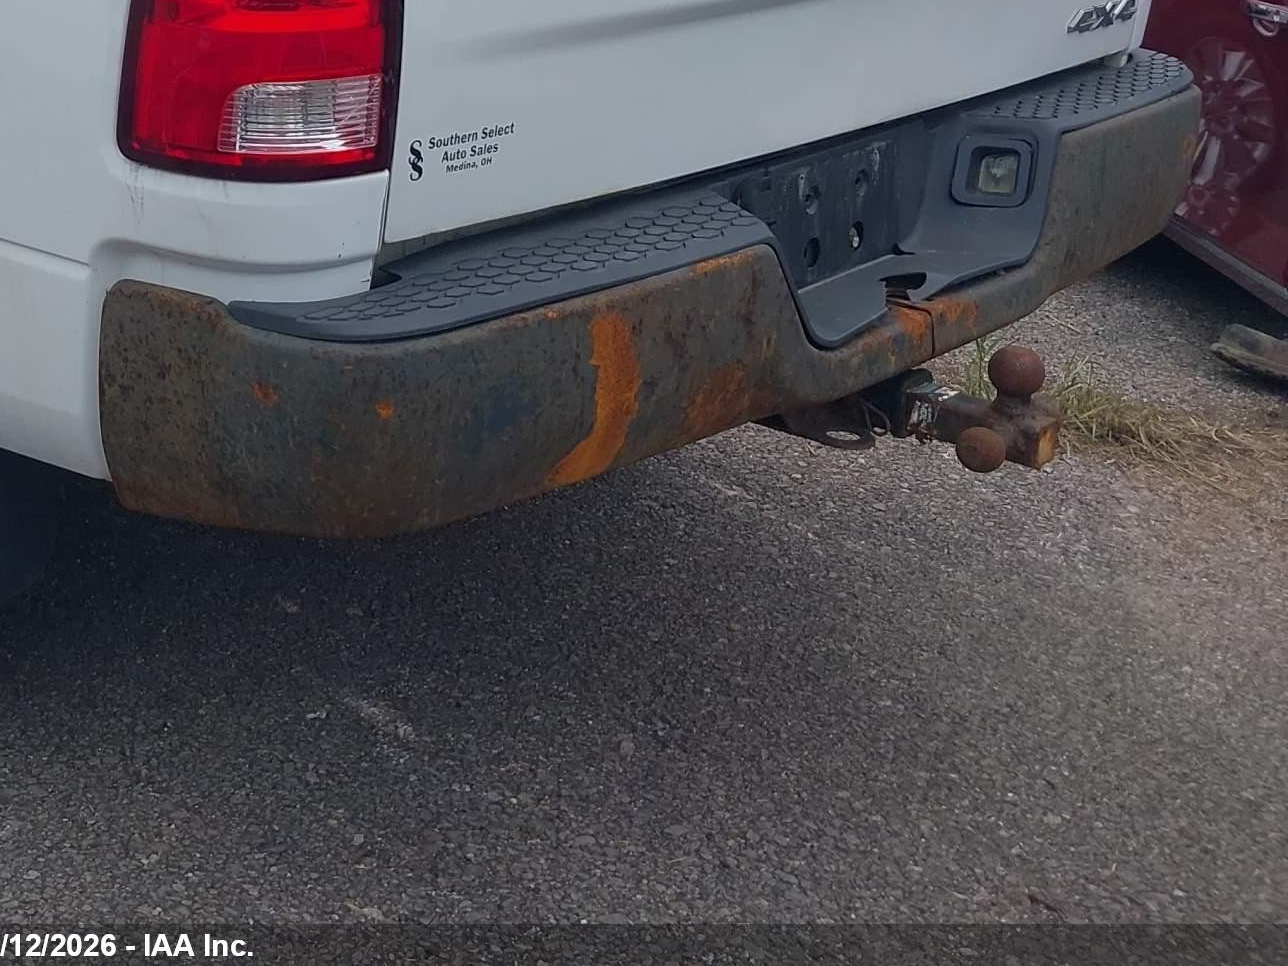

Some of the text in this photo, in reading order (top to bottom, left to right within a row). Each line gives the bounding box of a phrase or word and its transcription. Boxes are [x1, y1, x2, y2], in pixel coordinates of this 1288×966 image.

[428, 122, 514, 150] Southern Select
[441, 143, 499, 163] Auto Sales
[446, 157, 493, 173] Medina, OH
